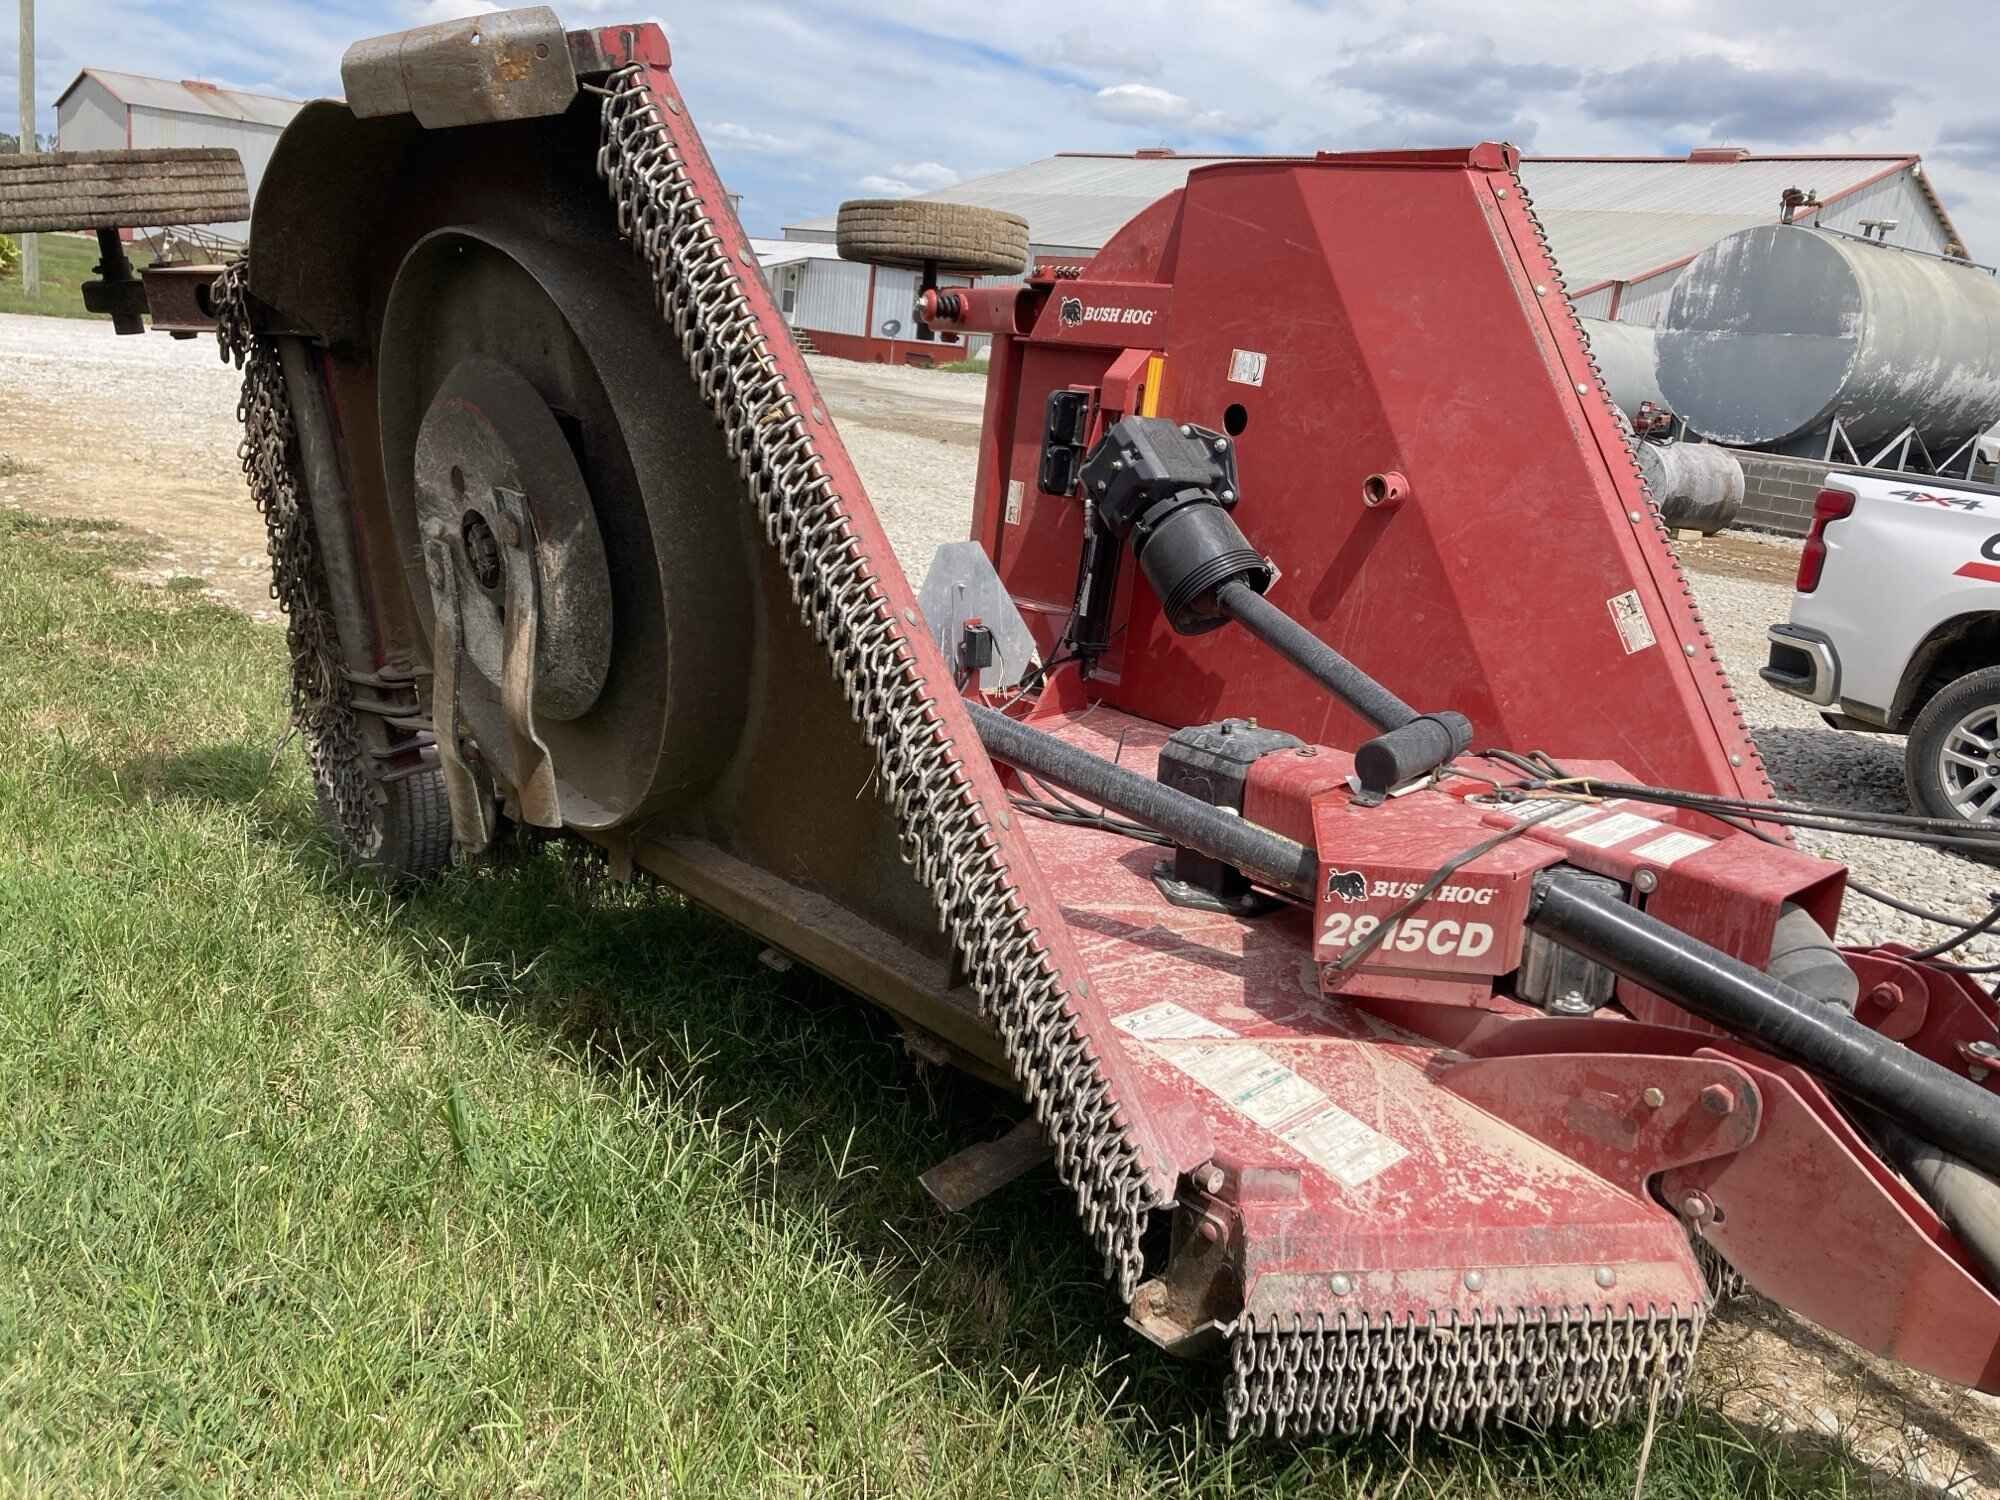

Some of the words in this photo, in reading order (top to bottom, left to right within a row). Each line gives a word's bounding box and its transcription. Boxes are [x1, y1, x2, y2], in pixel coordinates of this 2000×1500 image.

[1084, 306, 1121, 322] BUSH
[1121, 308, 1153, 325] HOG
[1437, 886, 1493, 905] HOG
[1318, 912, 1494, 957] 2815CD
